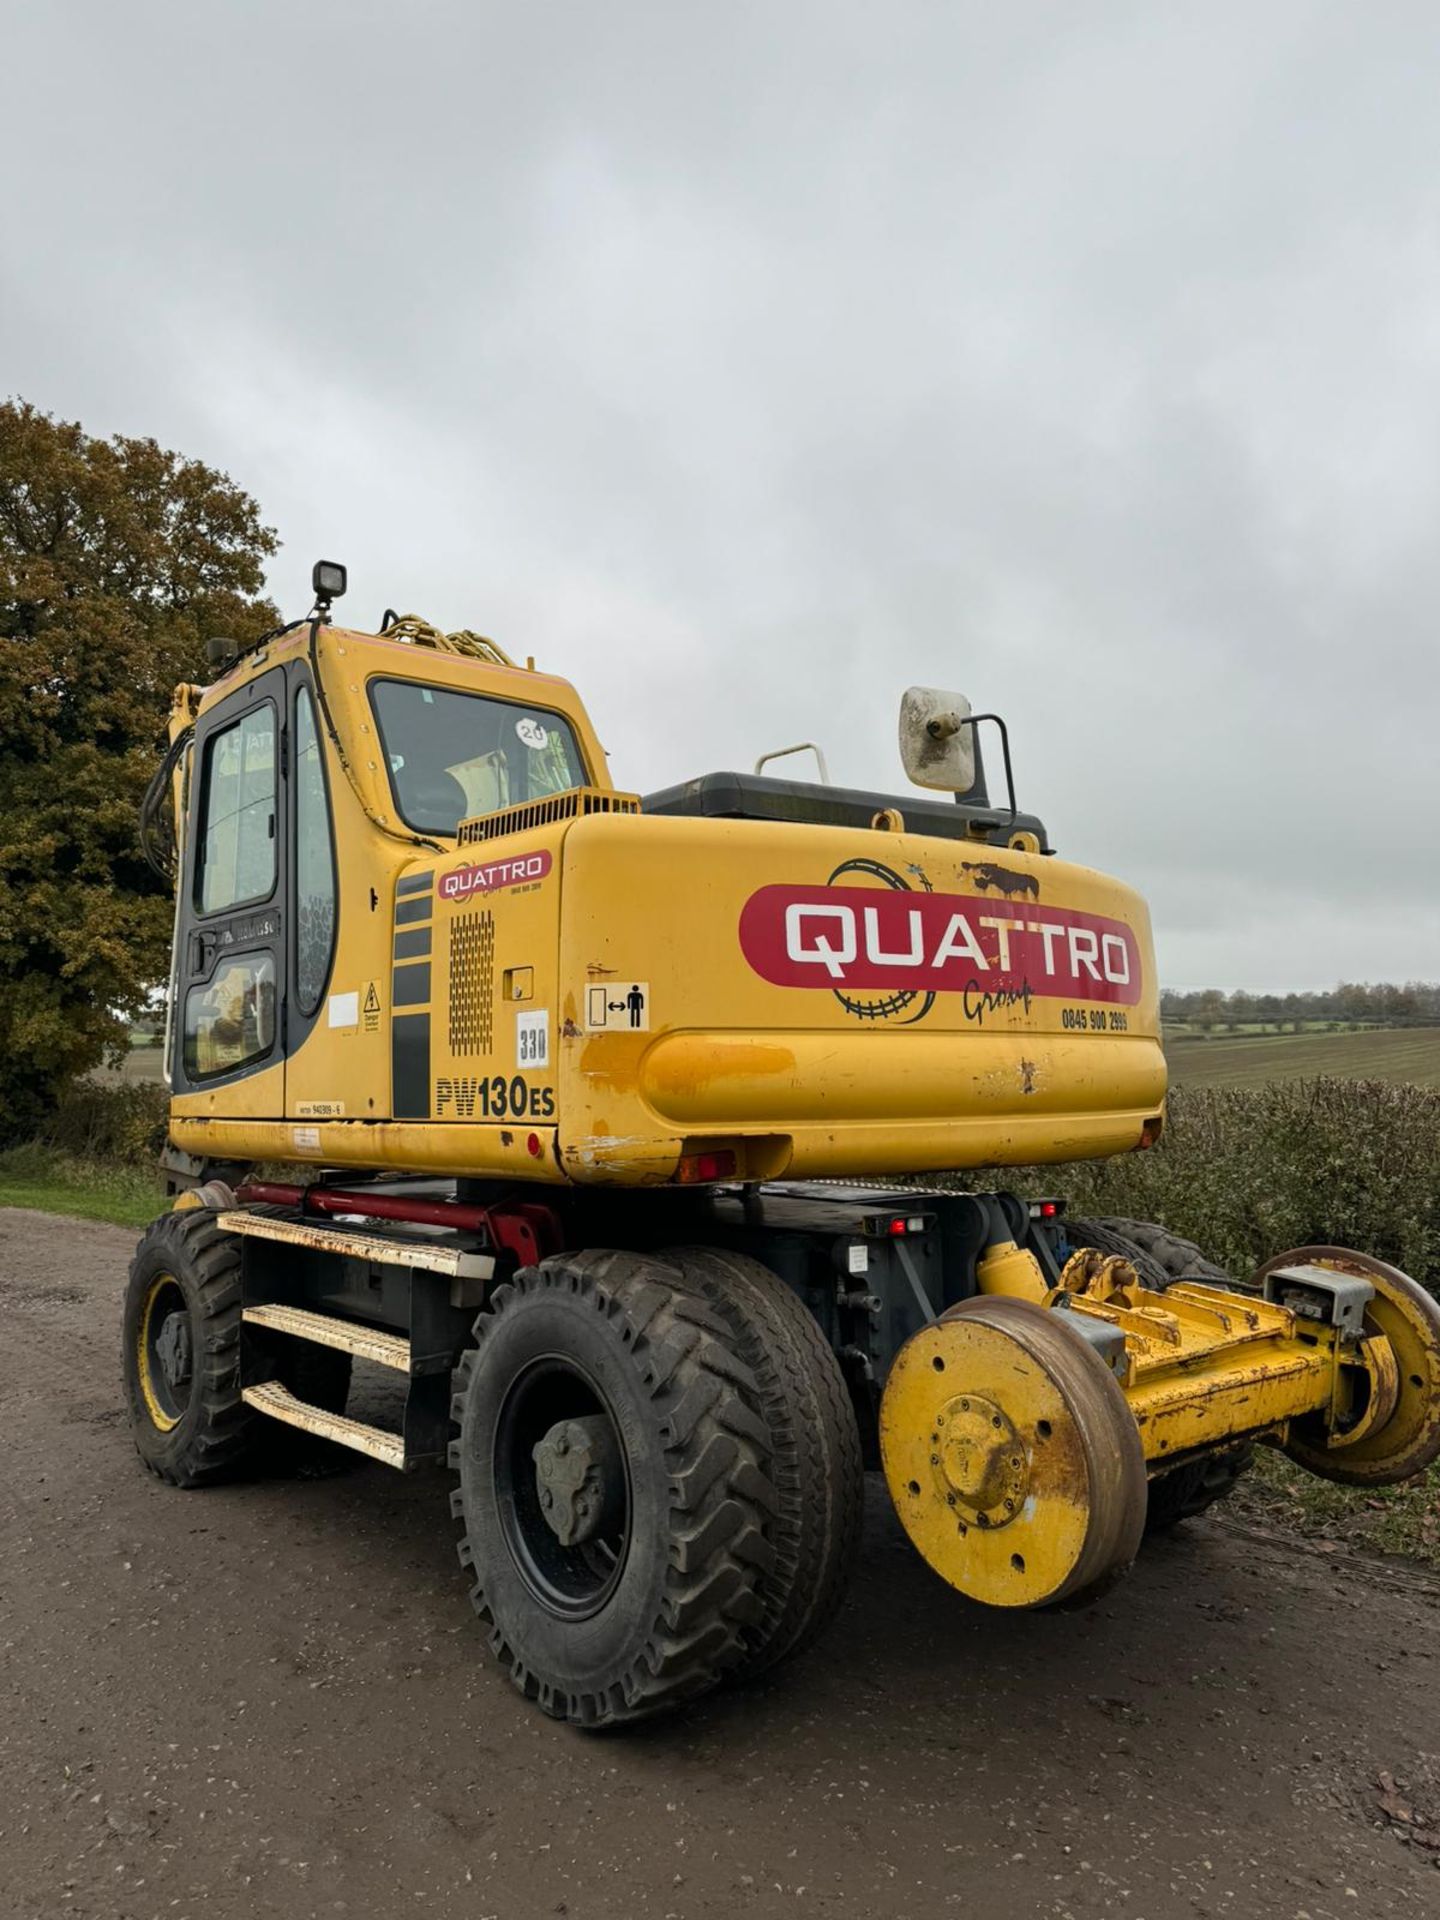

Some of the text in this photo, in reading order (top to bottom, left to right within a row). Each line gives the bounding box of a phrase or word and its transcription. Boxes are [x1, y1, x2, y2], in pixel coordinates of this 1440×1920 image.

[445, 857, 542, 896] QUATTRO
[785, 903, 1130, 985] QUATTRO
[963, 975, 1034, 1026] Group
[1062, 1008, 1087, 1029] 0845
[1090, 1010, 1106, 1030] 900
[520, 1028, 546, 1060] 330
[436, 1075, 555, 1117] PW130ES
